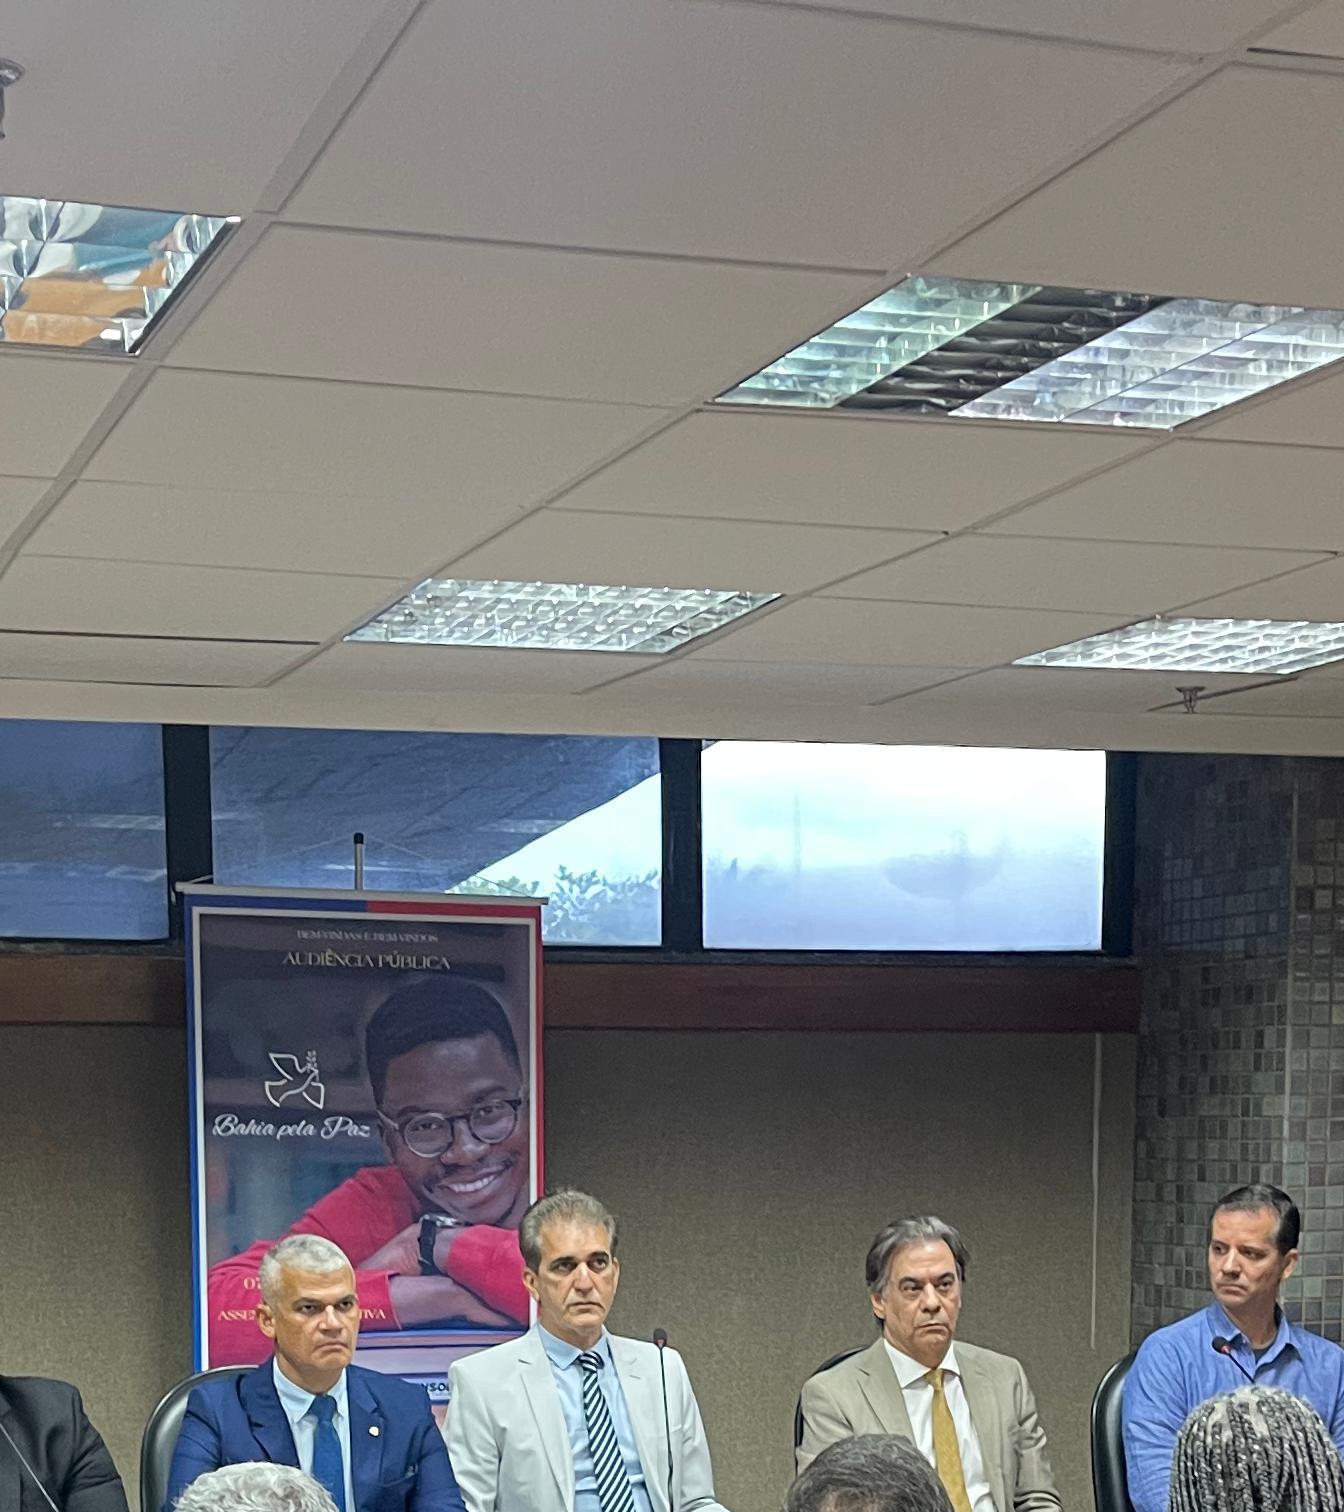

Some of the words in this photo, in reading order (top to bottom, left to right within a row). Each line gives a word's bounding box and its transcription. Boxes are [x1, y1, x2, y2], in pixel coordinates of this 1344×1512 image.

[282, 948, 375, 967] AUDIÊNCIA
[378, 950, 451, 970] PÚBLICA
[212, 1113, 275, 1137] Bahia
[276, 1119, 317, 1141] pela
[320, 1116, 371, 1139] Paz
